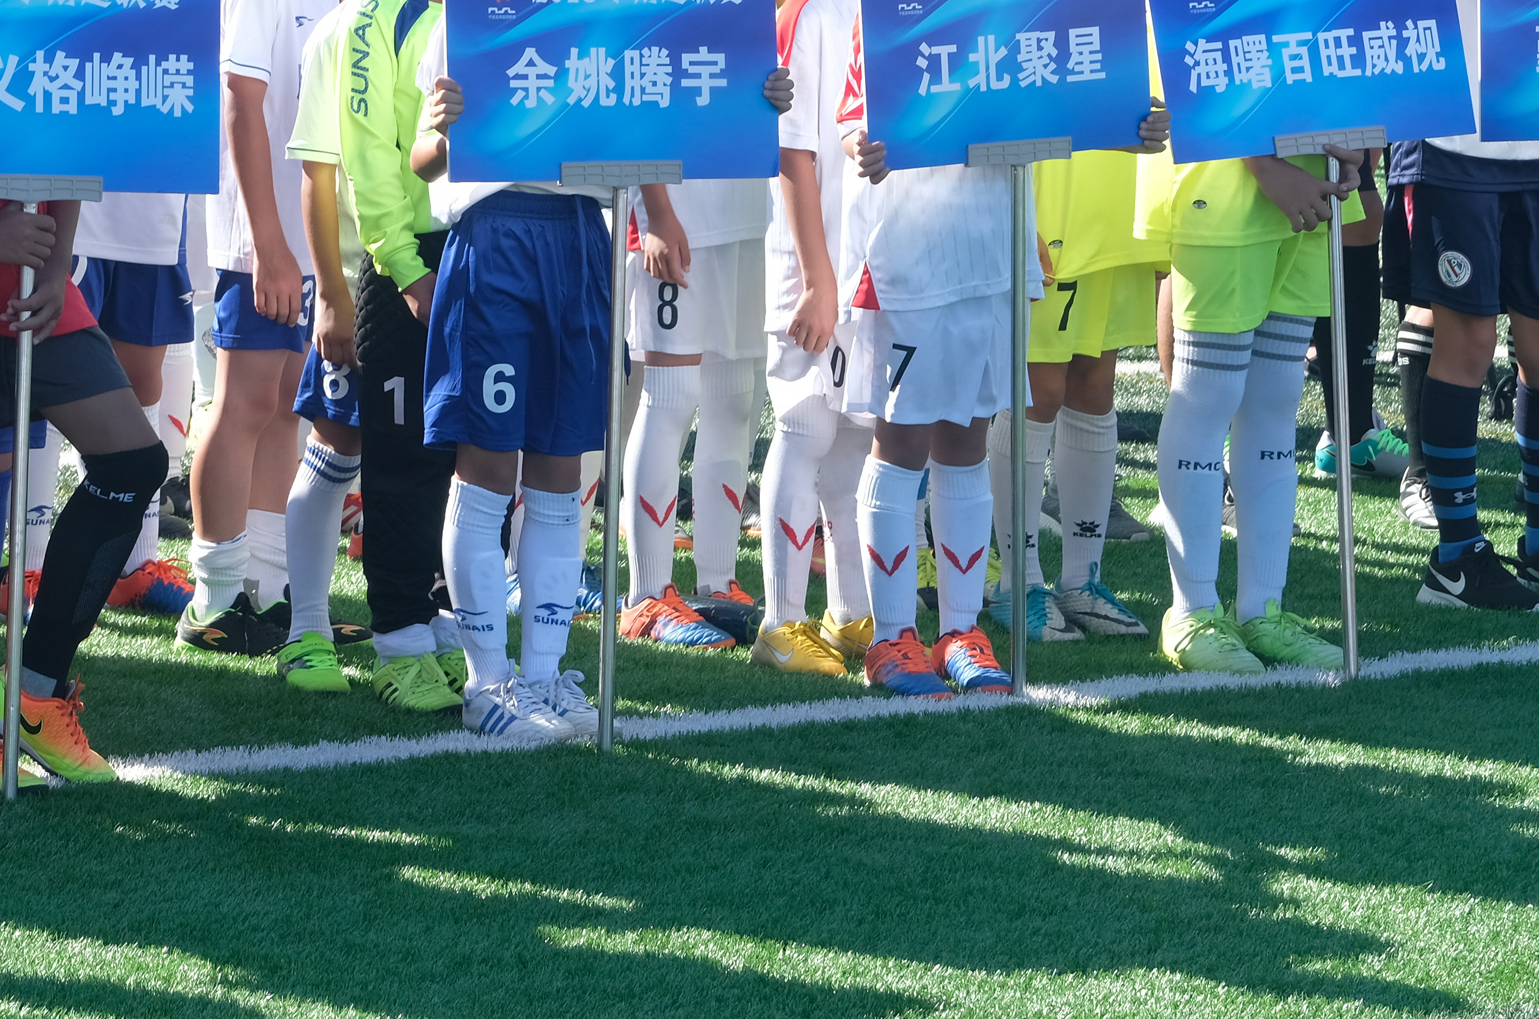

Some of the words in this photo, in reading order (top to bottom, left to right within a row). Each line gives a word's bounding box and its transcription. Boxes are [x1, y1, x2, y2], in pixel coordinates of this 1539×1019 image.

[506, 46, 728, 108] 余姚腾宇
[915, 26, 1106, 97] 江北聚星
[1183, 19, 1446, 94] 海曙百旺威视
[657, 281, 679, 330] 8
[1056, 280, 1078, 331] 7
[481, 363, 517, 414] 6
[889, 342, 918, 393] 7
[383, 376, 406, 426] 1
[83, 481, 136, 503] KELME
